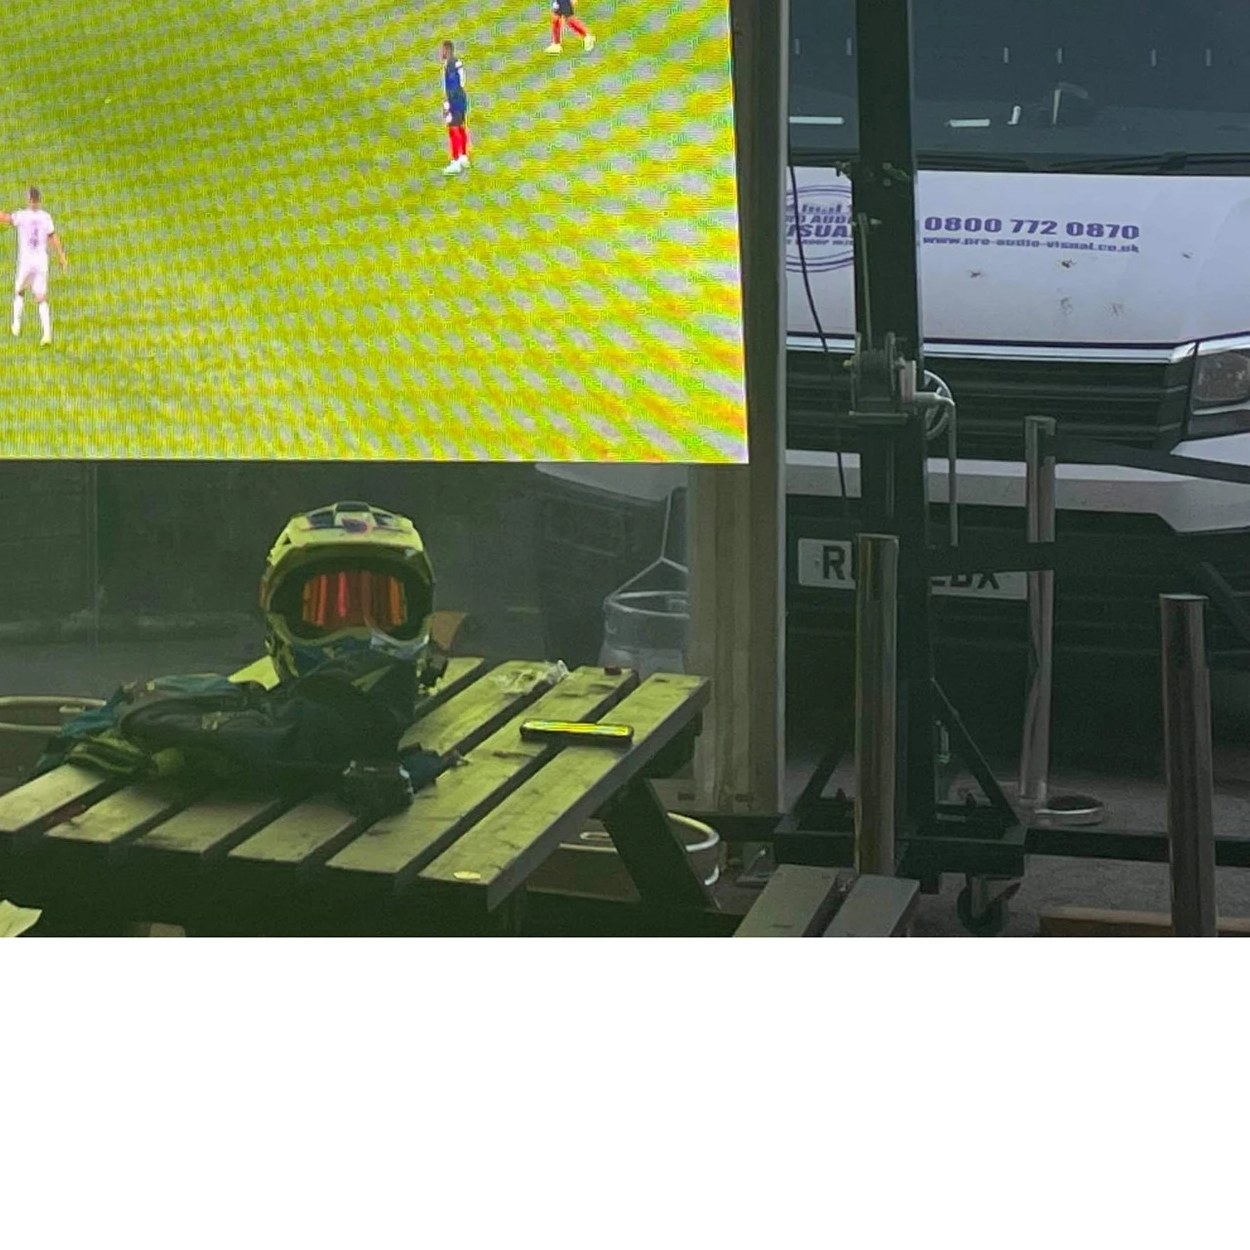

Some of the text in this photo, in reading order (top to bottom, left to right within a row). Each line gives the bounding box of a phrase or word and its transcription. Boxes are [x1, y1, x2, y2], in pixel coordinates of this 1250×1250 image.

[924, 216, 1140, 240] 0800 772 0870
[922, 235, 1140, 253] www.pro-audio-visual.co.uk
